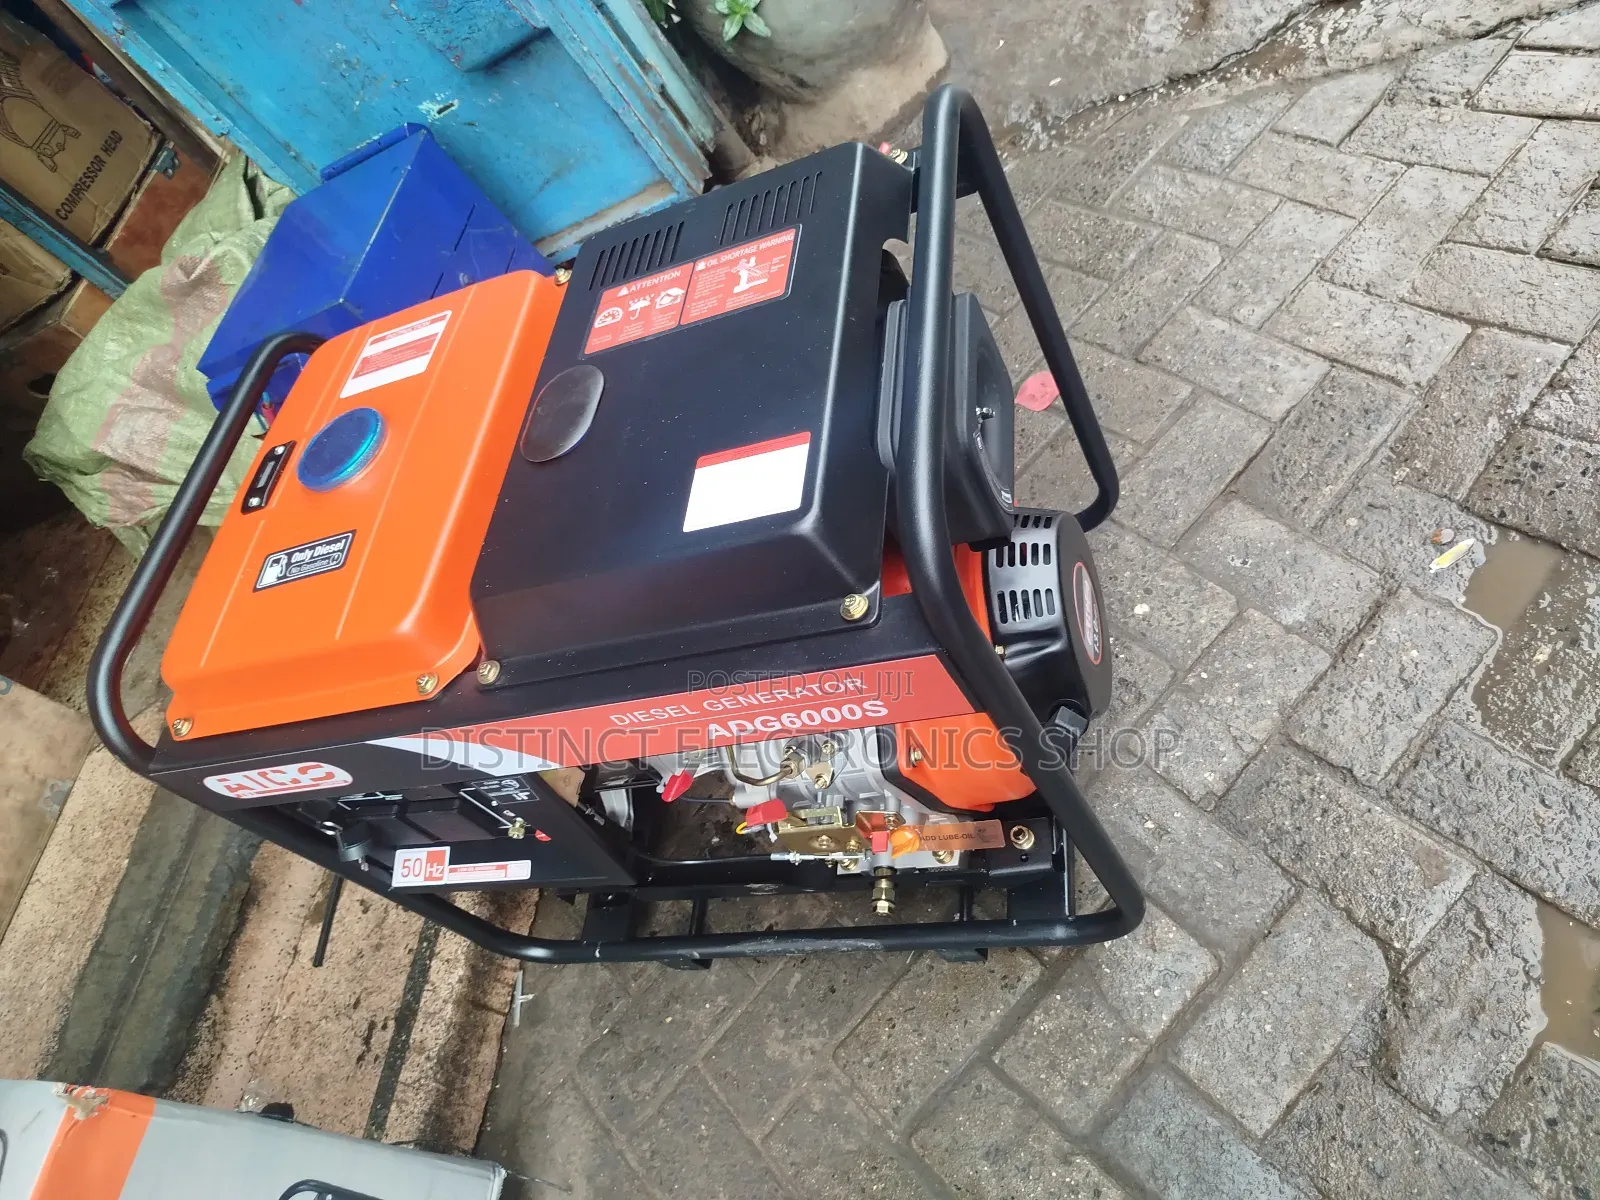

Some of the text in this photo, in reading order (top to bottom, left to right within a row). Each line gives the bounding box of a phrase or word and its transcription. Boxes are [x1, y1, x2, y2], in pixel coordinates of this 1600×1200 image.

[55, 129, 123, 221] COMPRESSOR HEAD
[719, 244, 759, 263] SHORTAGE
[759, 233, 795, 250] WARNING
[628, 269, 681, 293] ATTENTION
[291, 538, 346, 563] Only Diesel
[290, 558, 329, 574] No Gasoline
[609, 678, 868, 727] DIESEL GENERATOR
[707, 700, 890, 741] ADG6000S
[938, 833, 975, 841] LUBE-OIL
[401, 857, 423, 878] 50
[425, 862, 445, 878] Hz
